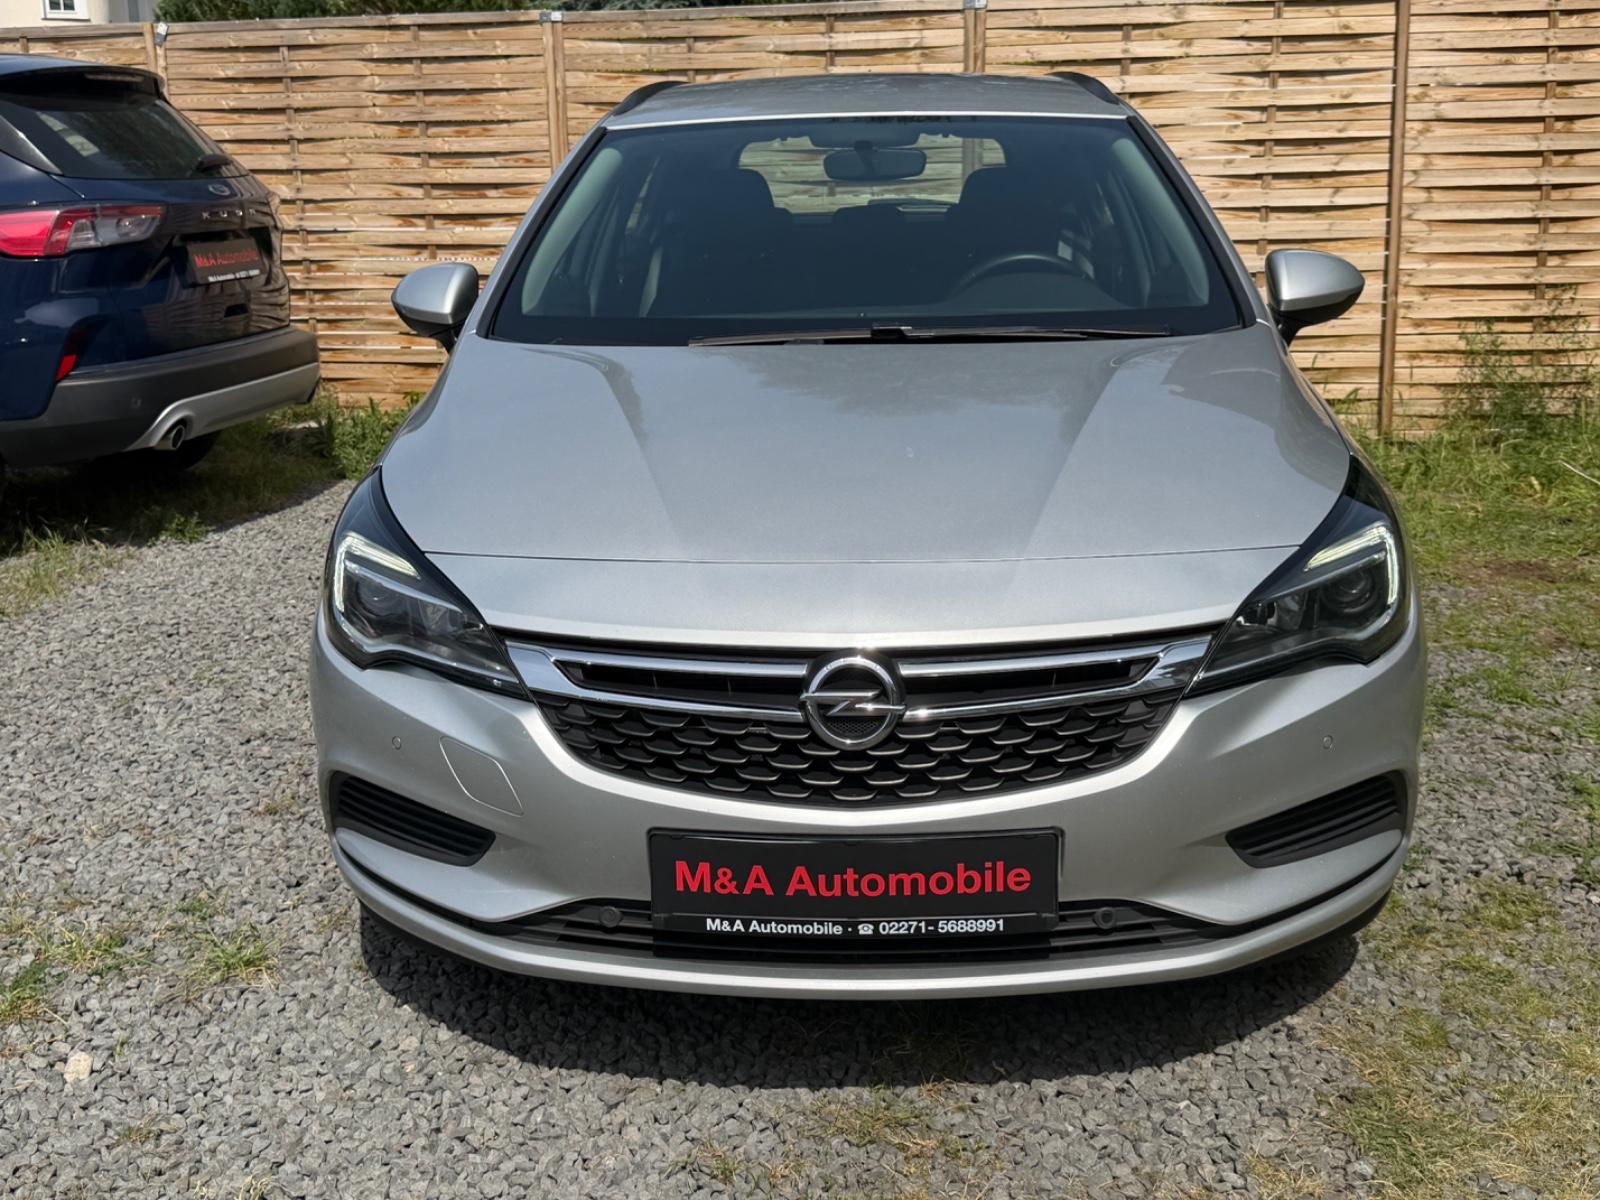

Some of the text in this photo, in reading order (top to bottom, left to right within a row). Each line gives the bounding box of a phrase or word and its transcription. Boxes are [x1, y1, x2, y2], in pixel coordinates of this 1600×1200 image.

[675, 860, 1032, 897] M&A Automobile
[706, 918, 745, 932] M&A
[749, 920, 843, 935] Automobile
